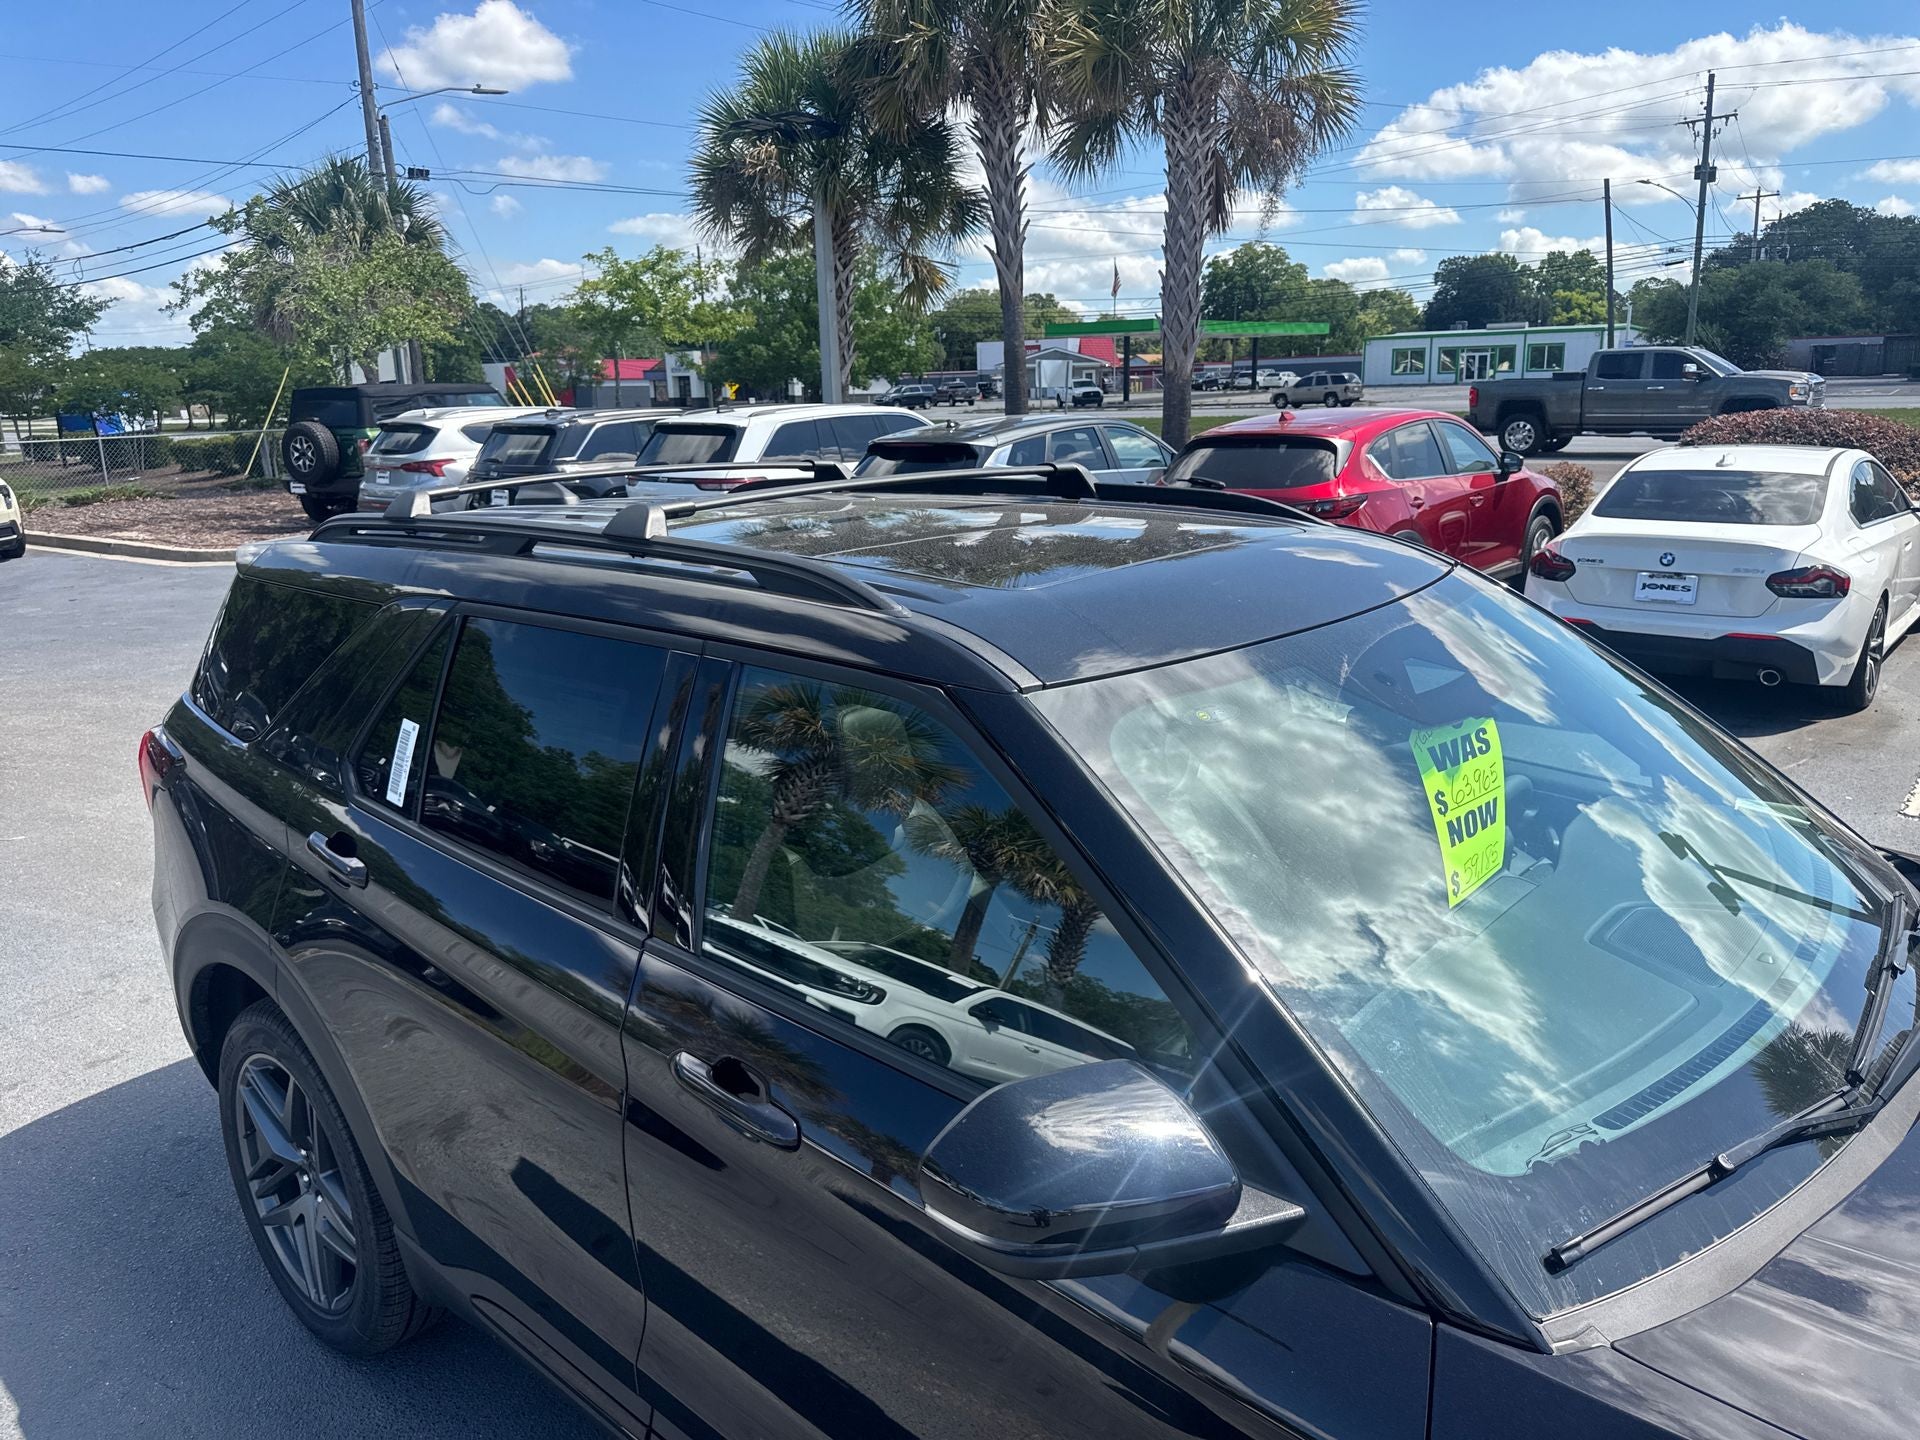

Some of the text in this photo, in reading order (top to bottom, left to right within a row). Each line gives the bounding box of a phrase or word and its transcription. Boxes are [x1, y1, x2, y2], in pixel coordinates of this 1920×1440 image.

[1640, 582, 1692, 592] JONES
[1427, 728, 1491, 772] WAS
[1434, 762, 1498, 817] $ 63,965
[1446, 796, 1498, 848] NOW
[1451, 870, 1460, 898] $
